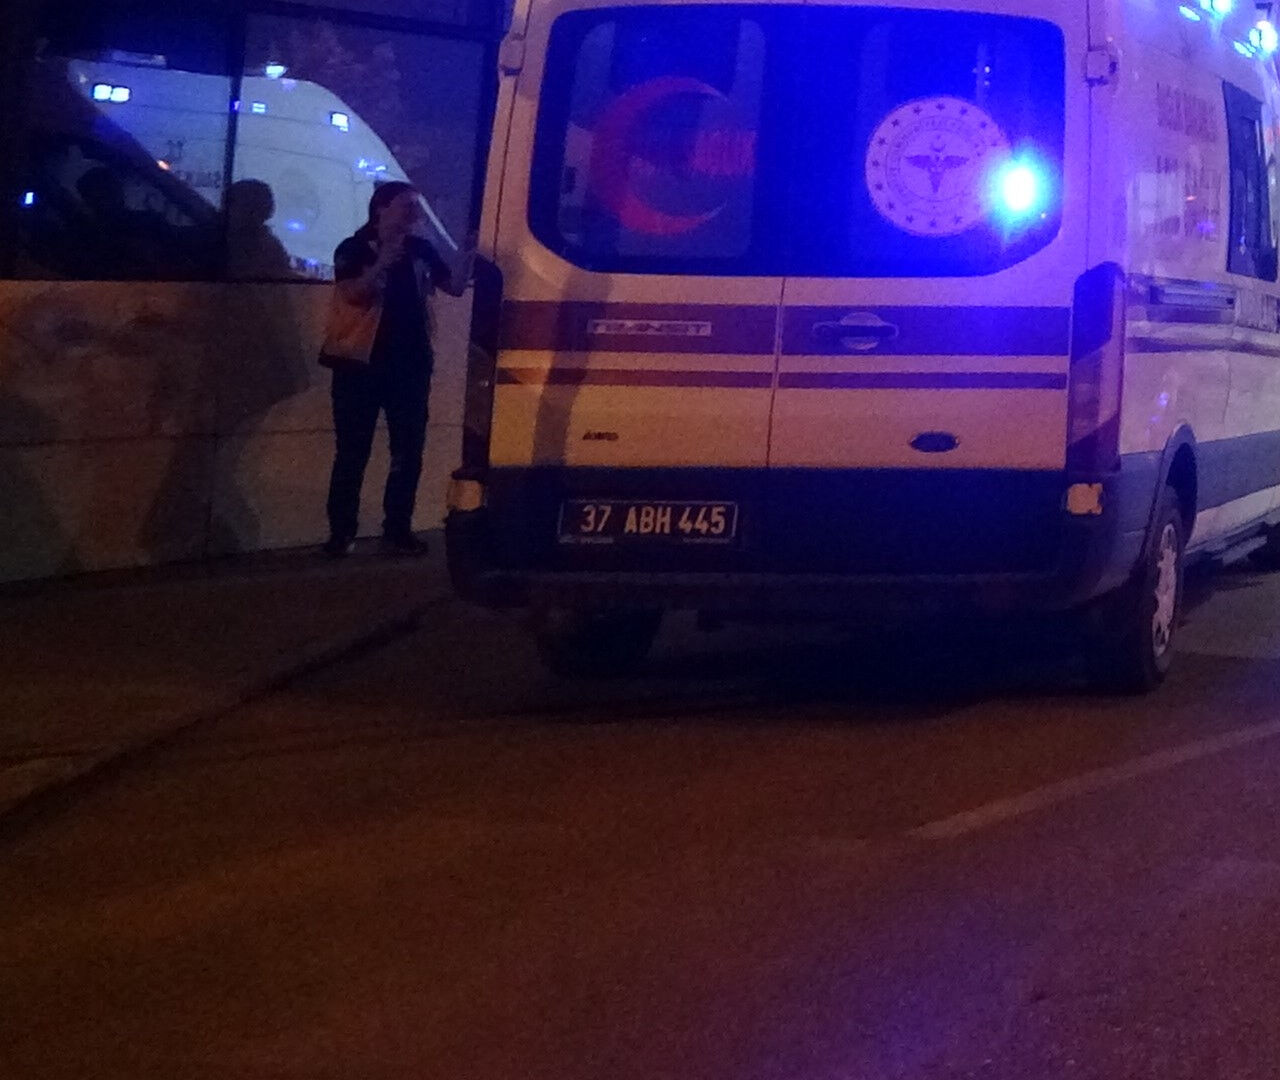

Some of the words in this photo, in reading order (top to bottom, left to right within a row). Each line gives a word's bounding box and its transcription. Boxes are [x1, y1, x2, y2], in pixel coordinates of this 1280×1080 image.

[580, 504, 612, 533] 37
[624, 506, 672, 535] ABH
[678, 505, 727, 535] 445
